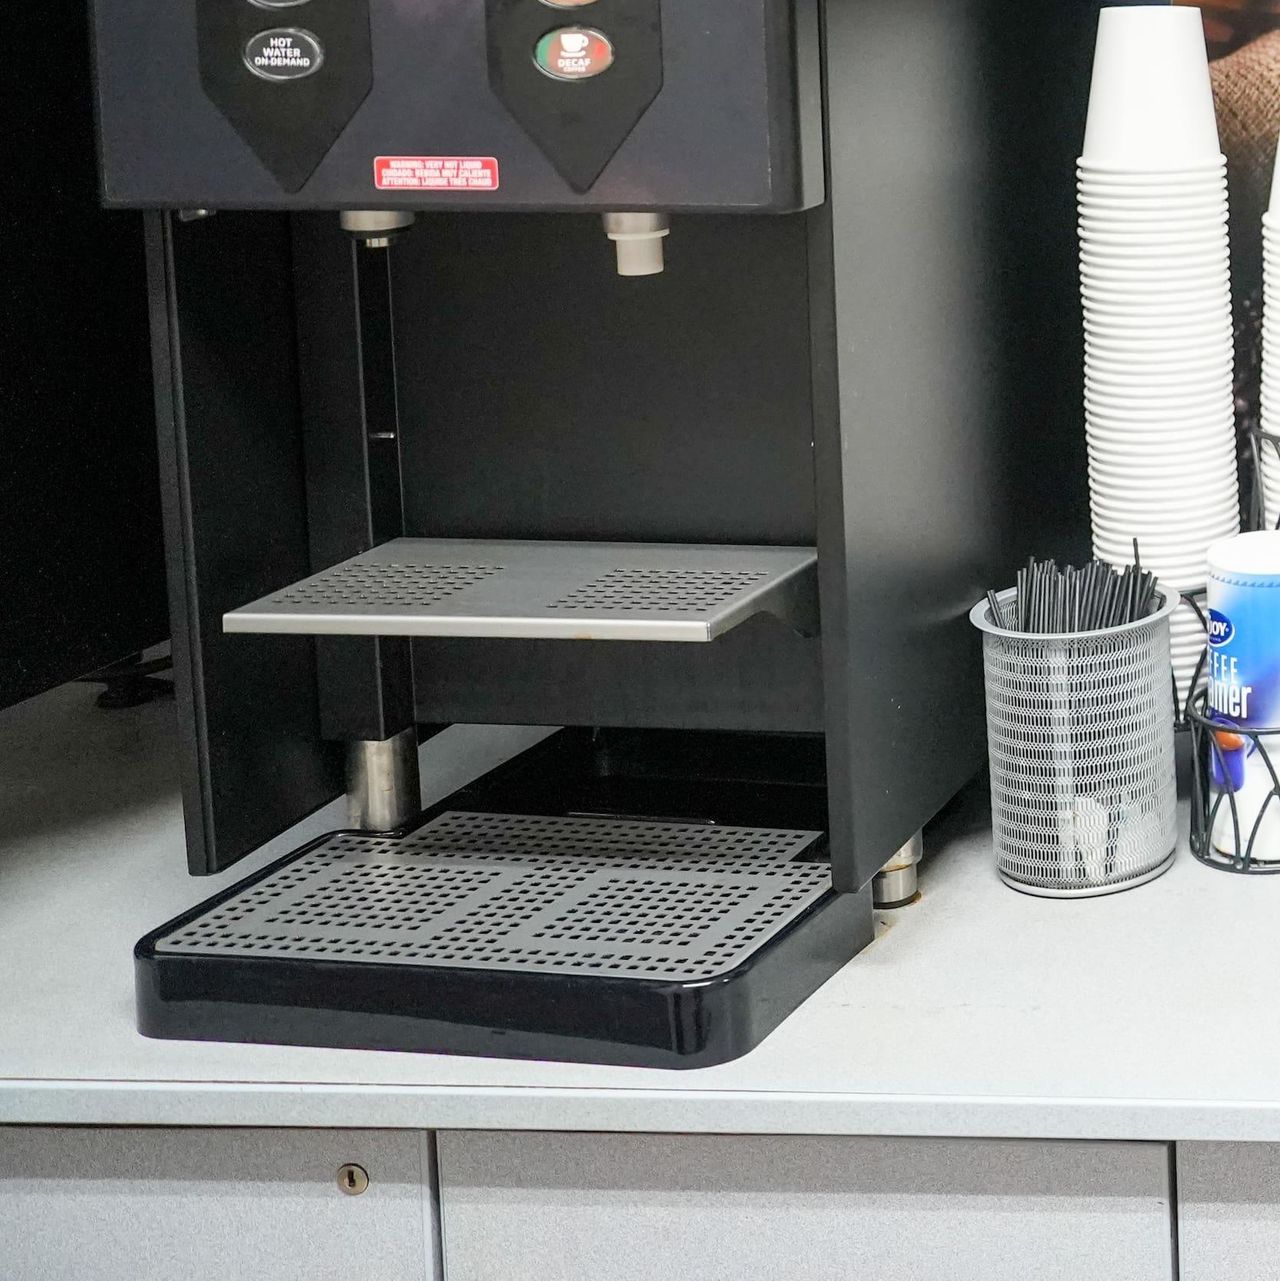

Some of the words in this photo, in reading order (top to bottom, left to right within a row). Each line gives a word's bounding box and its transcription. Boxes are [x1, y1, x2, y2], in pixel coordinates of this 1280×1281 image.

[269, 38, 293, 47] HOT
[262, 47, 300, 58] WATER
[557, 59, 591, 68] DECAF
